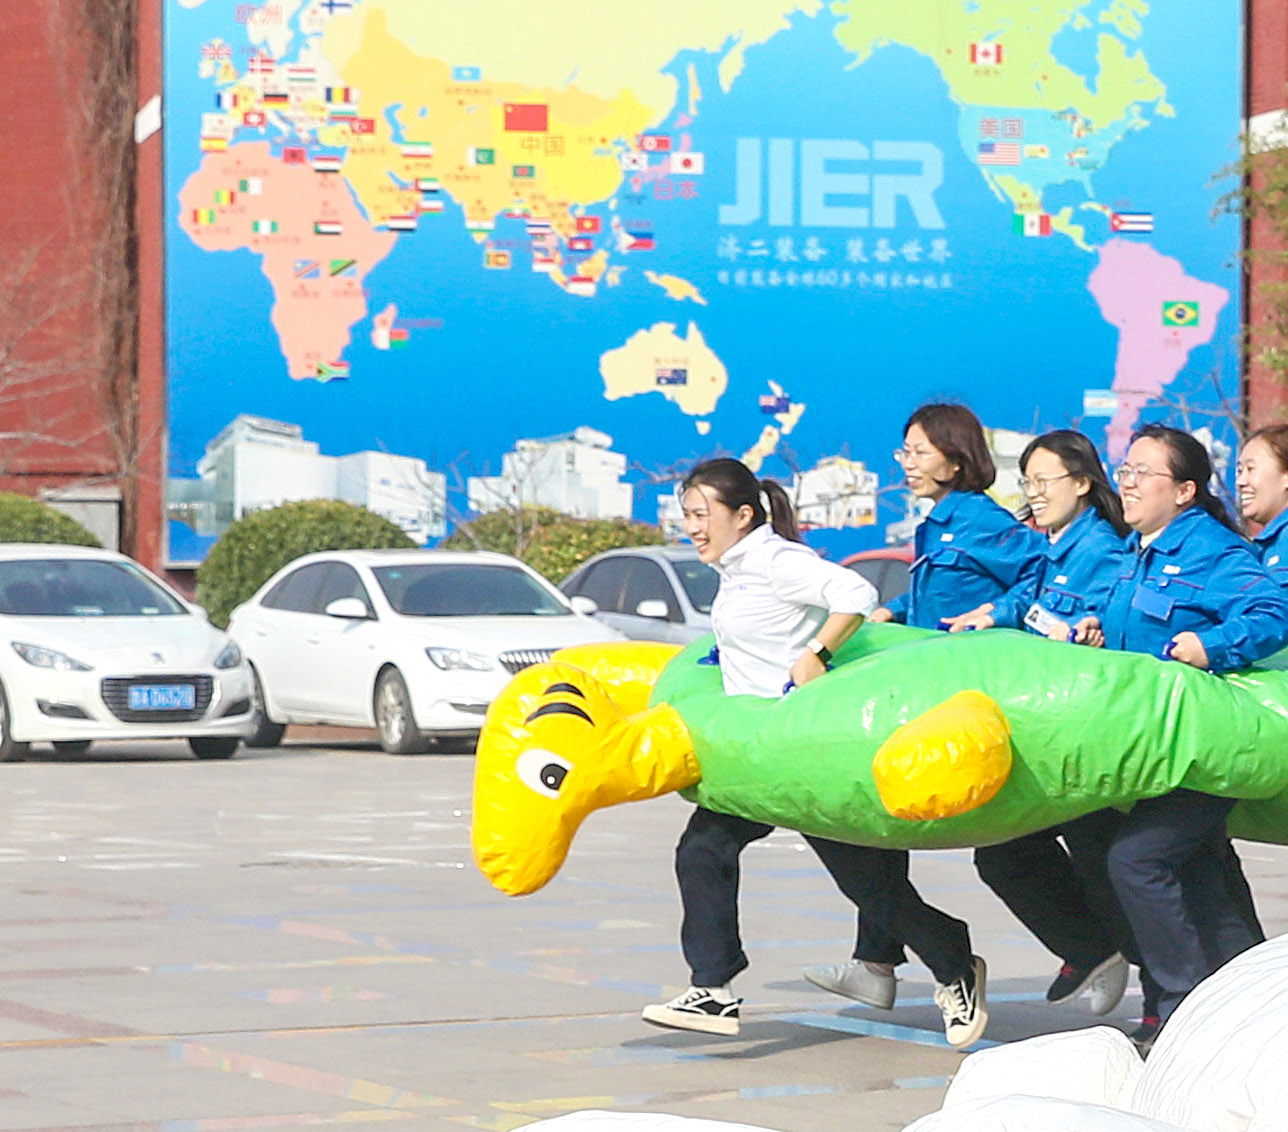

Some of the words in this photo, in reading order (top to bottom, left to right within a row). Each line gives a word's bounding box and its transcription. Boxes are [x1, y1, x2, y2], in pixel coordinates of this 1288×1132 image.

[979, 118, 1024, 139] 美国
[521, 136, 565, 156] 中国
[653, 179, 698, 200] 日本
[718, 138, 947, 230] JIER
